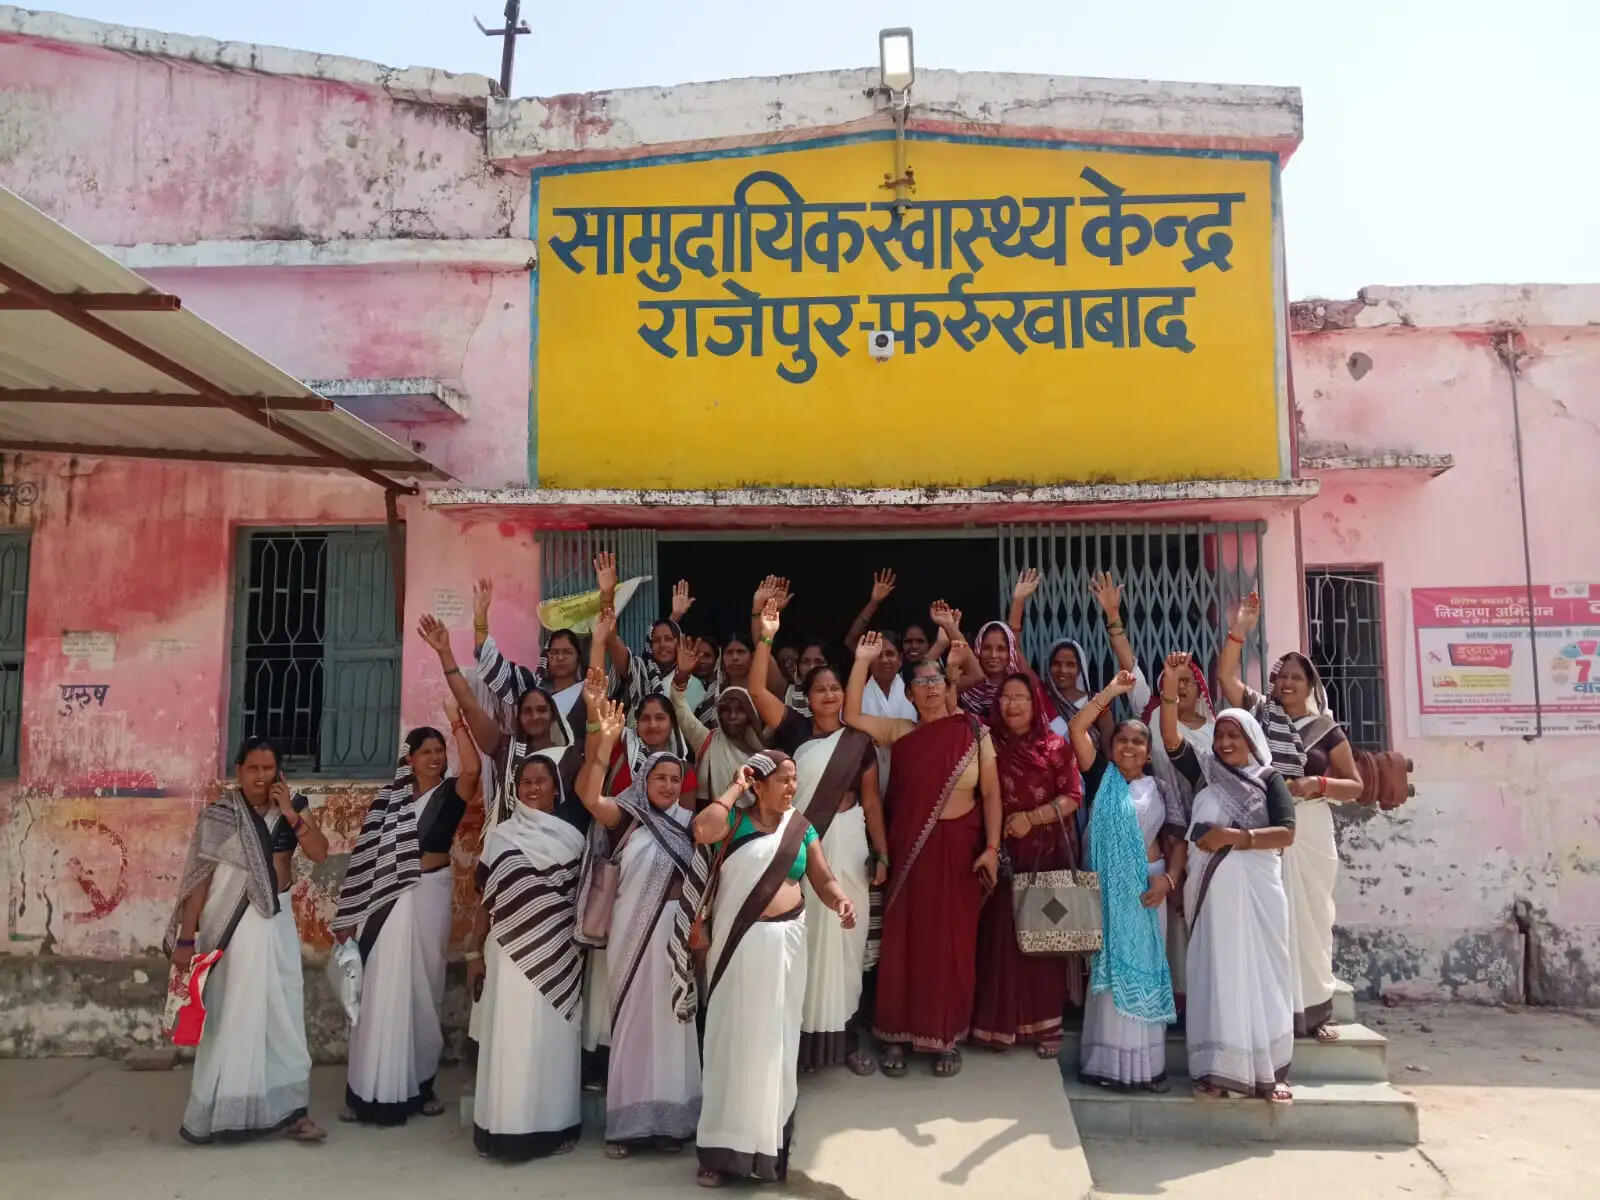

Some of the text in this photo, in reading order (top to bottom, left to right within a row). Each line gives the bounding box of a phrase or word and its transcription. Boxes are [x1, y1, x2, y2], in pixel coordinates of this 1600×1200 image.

[550, 167, 1245, 292] सामुदायिक स्वास्थ्य केन्द्र
[1576, 660, 1592, 683] 7
